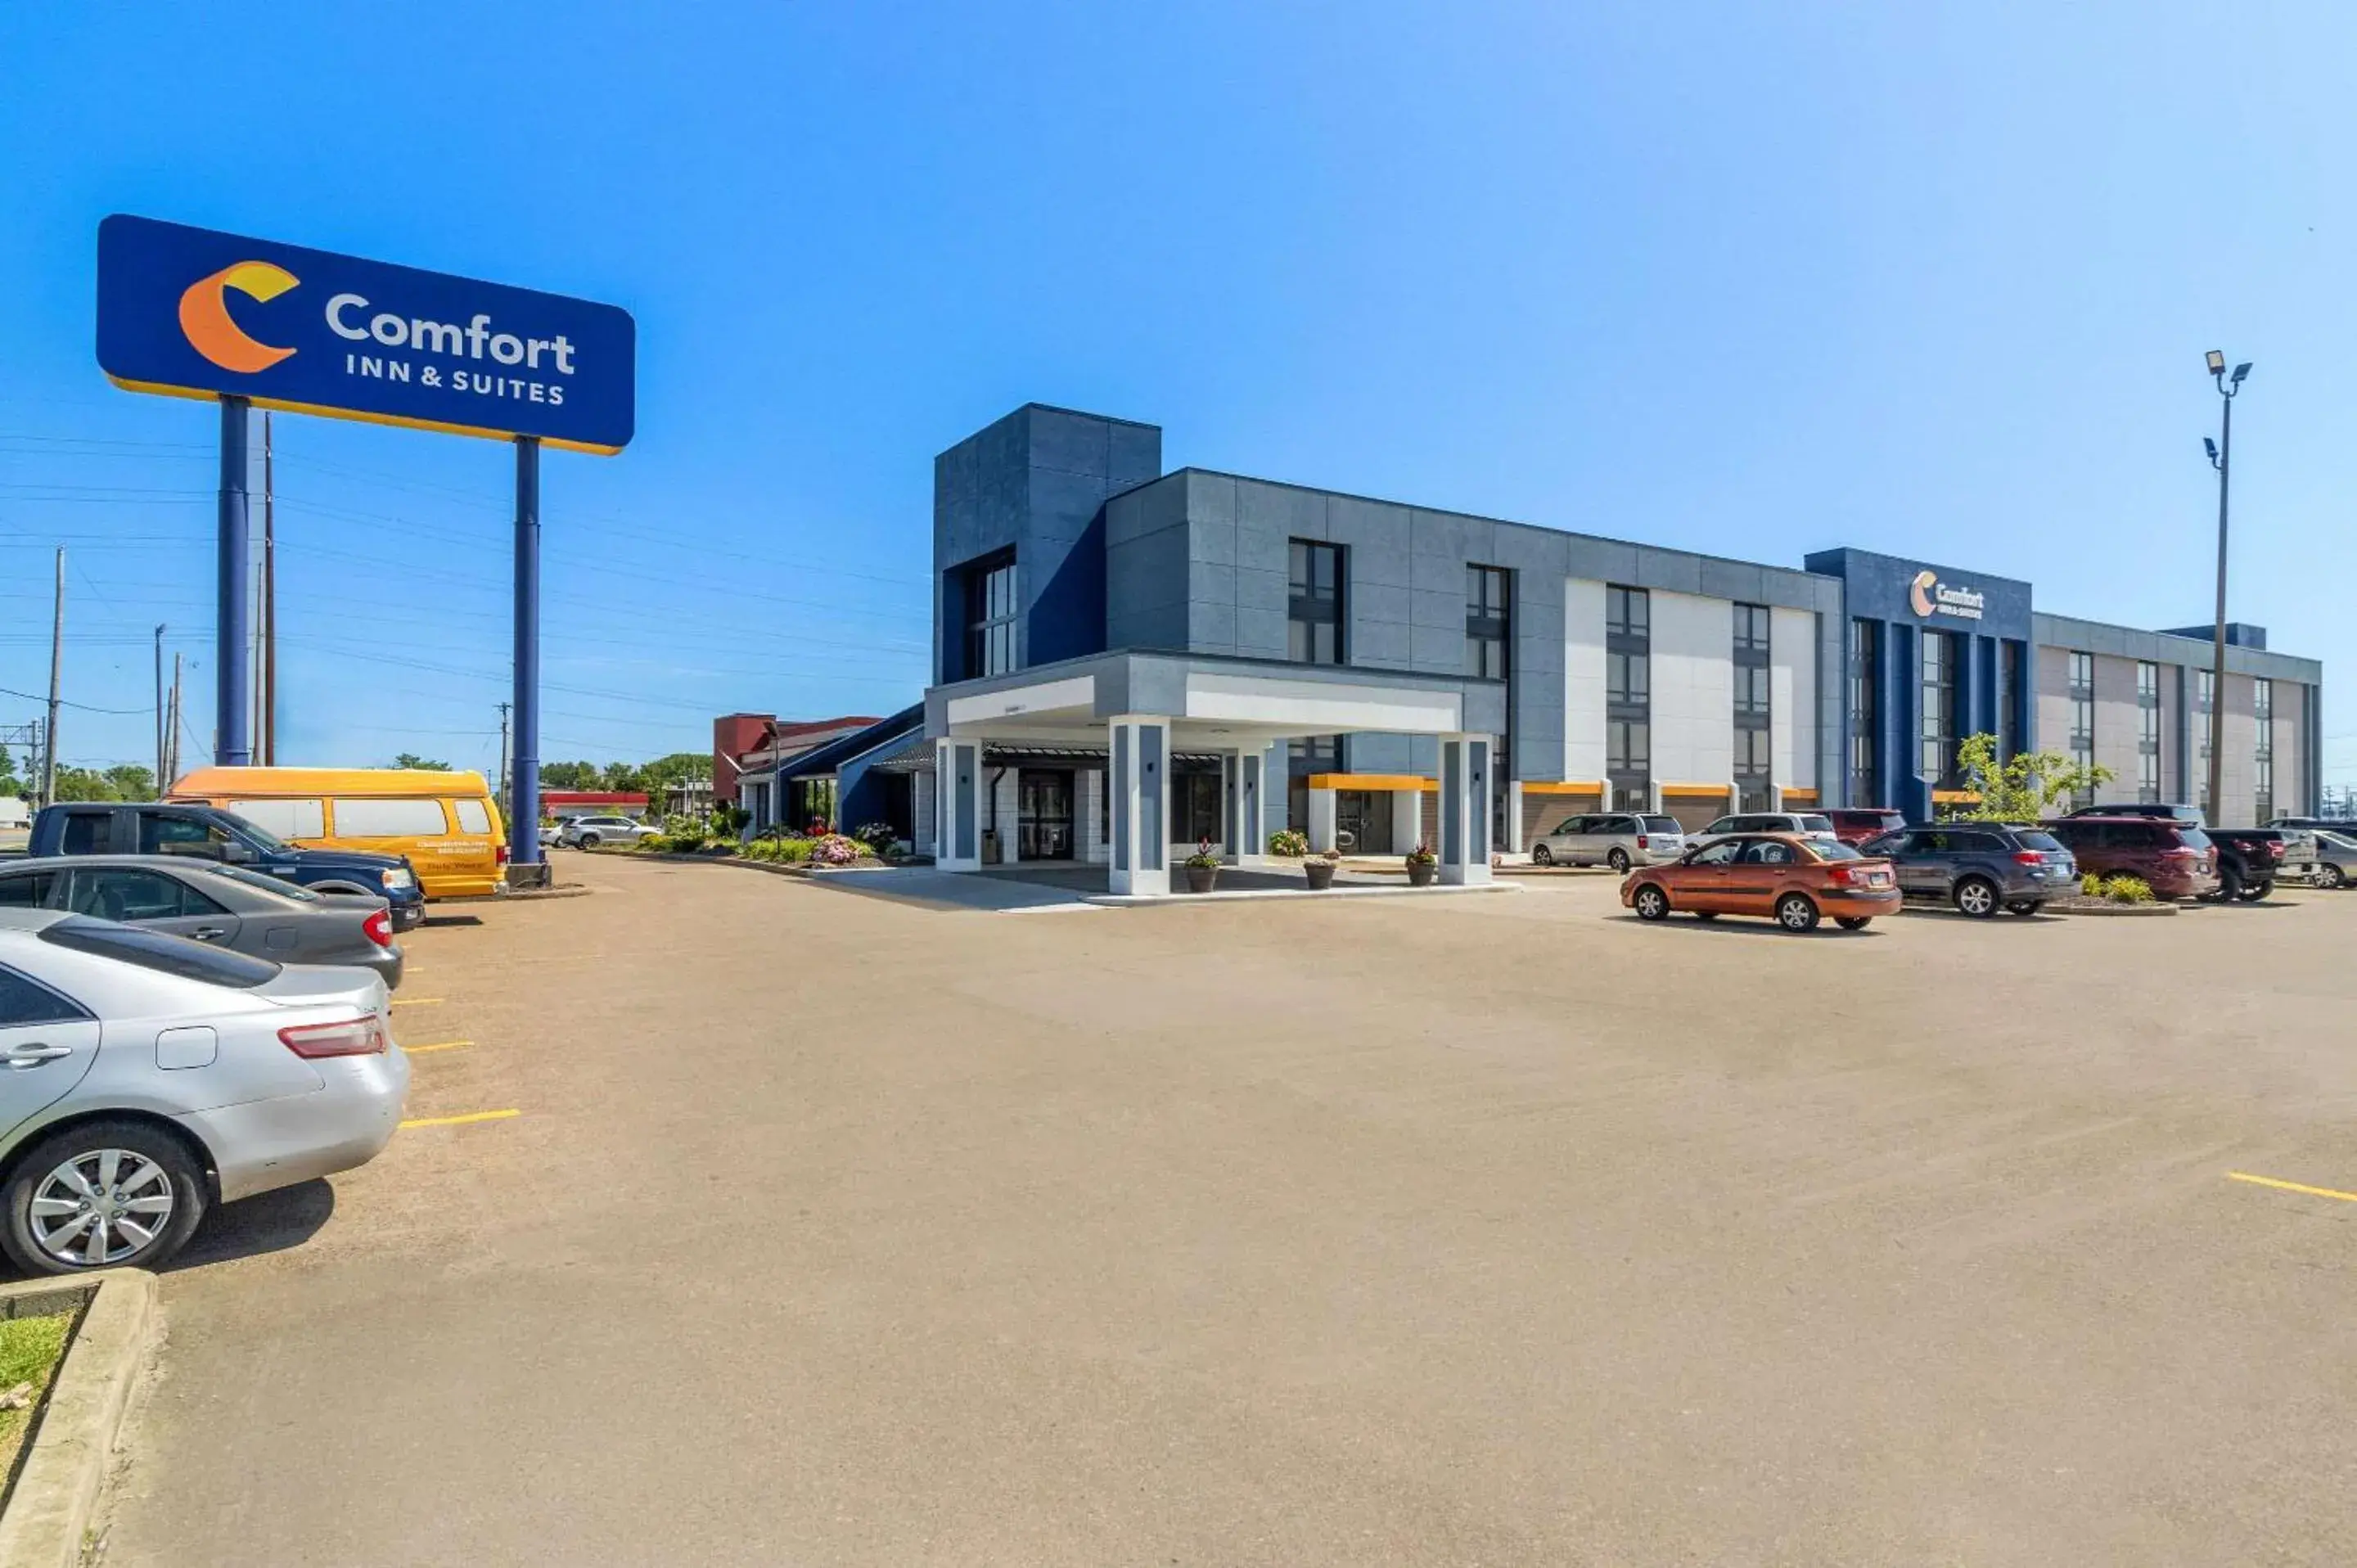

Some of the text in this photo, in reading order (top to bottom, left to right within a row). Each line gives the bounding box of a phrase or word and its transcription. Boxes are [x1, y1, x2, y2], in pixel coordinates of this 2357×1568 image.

[326, 293, 575, 375] Comfort
[347, 354, 563, 405] INN & SUITES
[1936, 583, 1984, 608] Comfort
